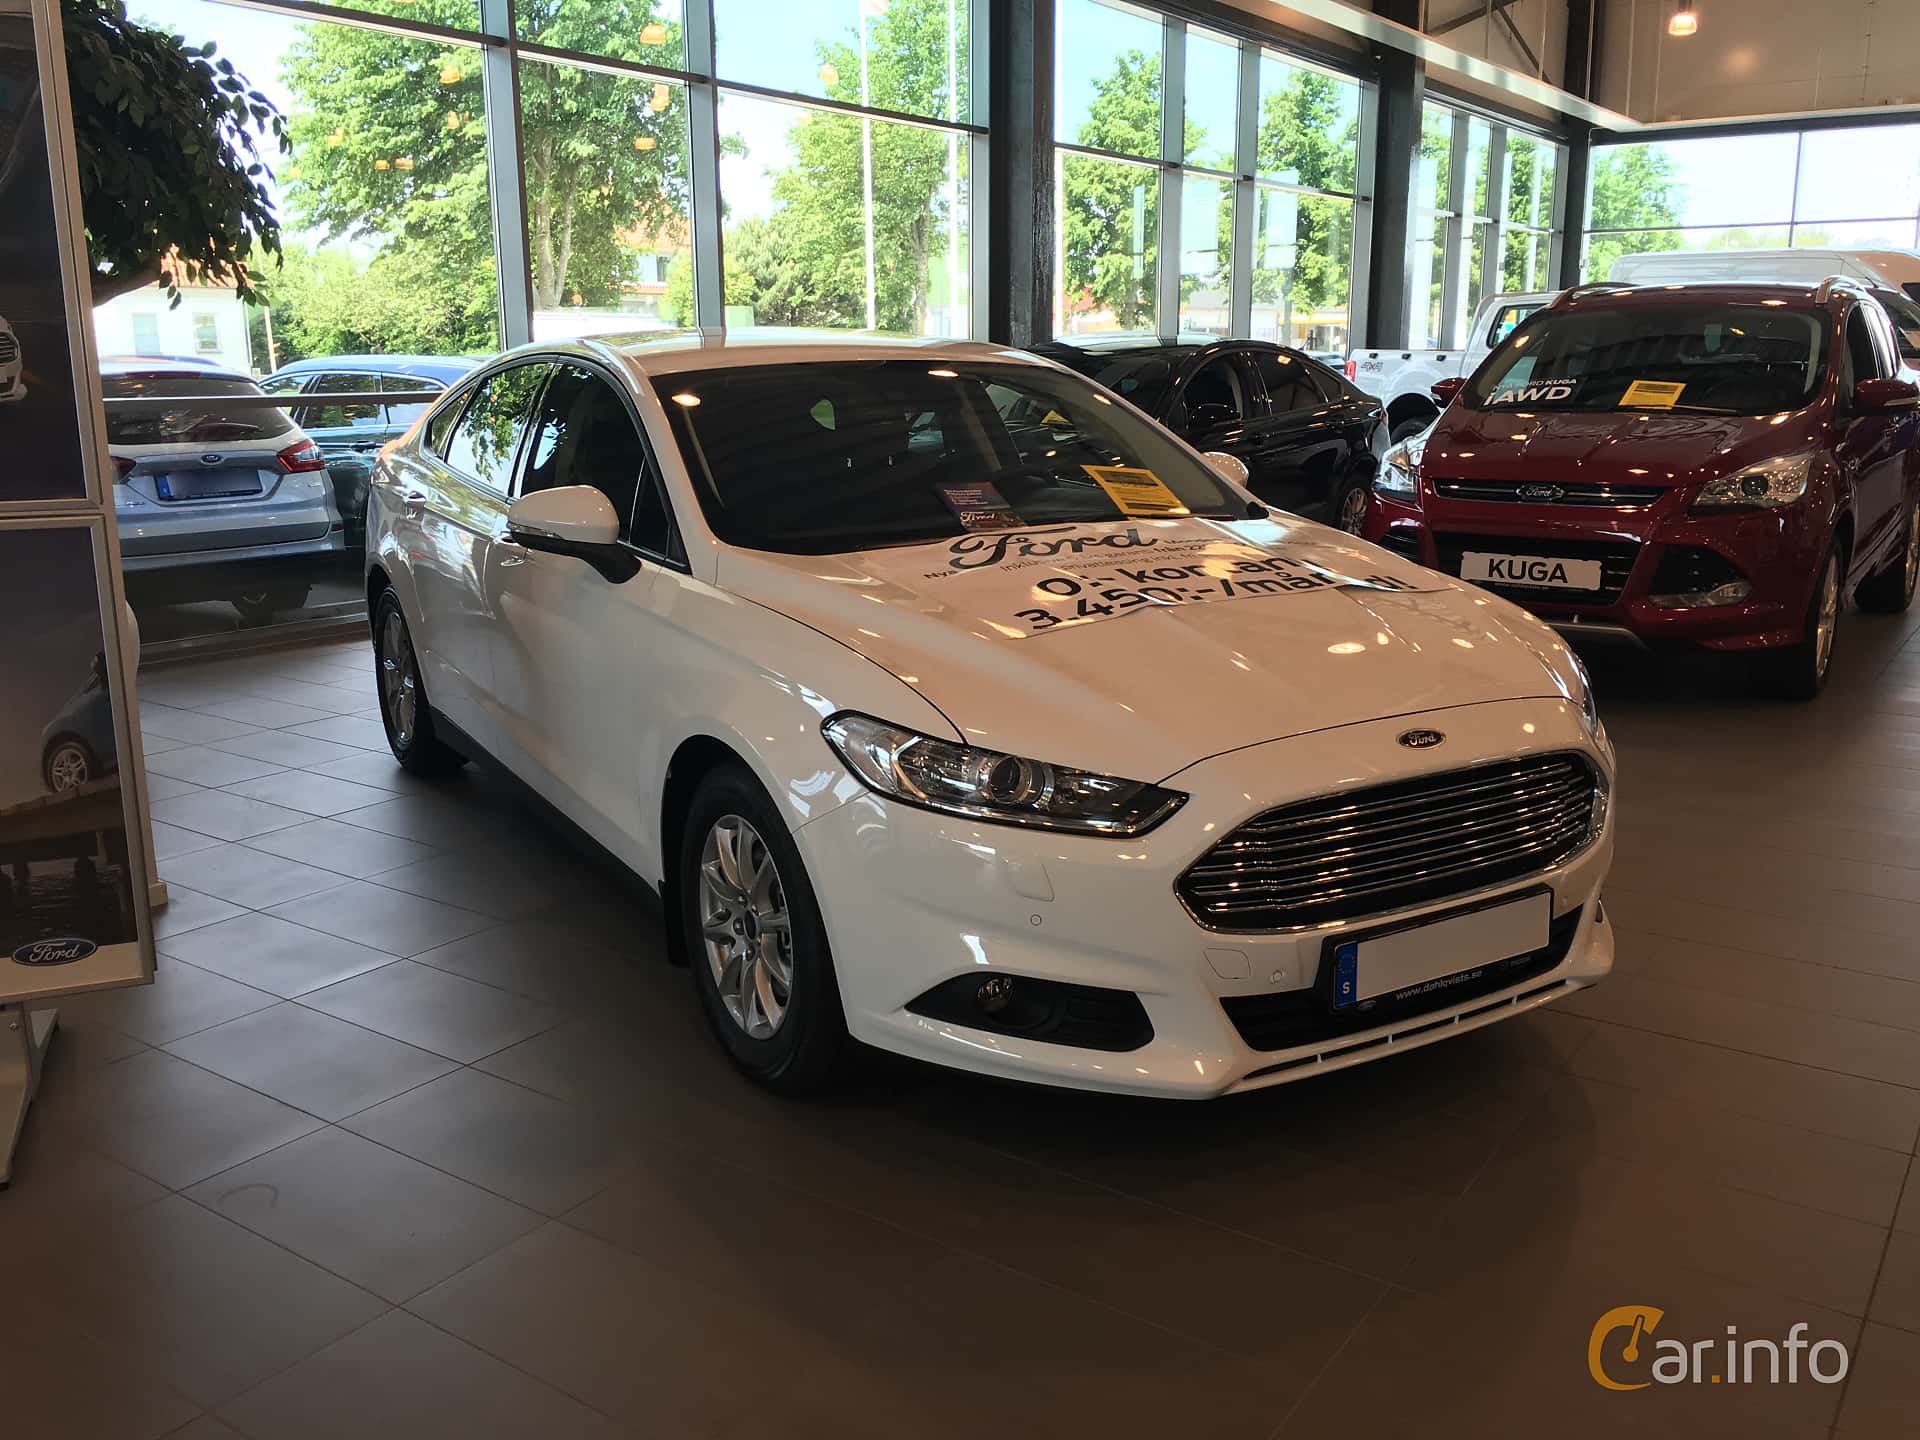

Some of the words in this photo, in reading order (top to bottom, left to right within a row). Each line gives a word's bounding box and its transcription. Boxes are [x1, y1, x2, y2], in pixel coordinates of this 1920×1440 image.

[1545, 378, 1577, 386] KUGA
[1483, 386, 1572, 407] iAWD
[1526, 486, 1553, 498] Ford
[949, 526, 1158, 570] Ford
[1114, 557, 1326, 584] konan
[1487, 559, 1568, 584] KUGA
[1013, 571, 1418, 630] 3.450:-/måd!
[1407, 731, 1437, 746] Ford
[29, 941, 82, 963] Ford
[1342, 981, 1351, 994] S
